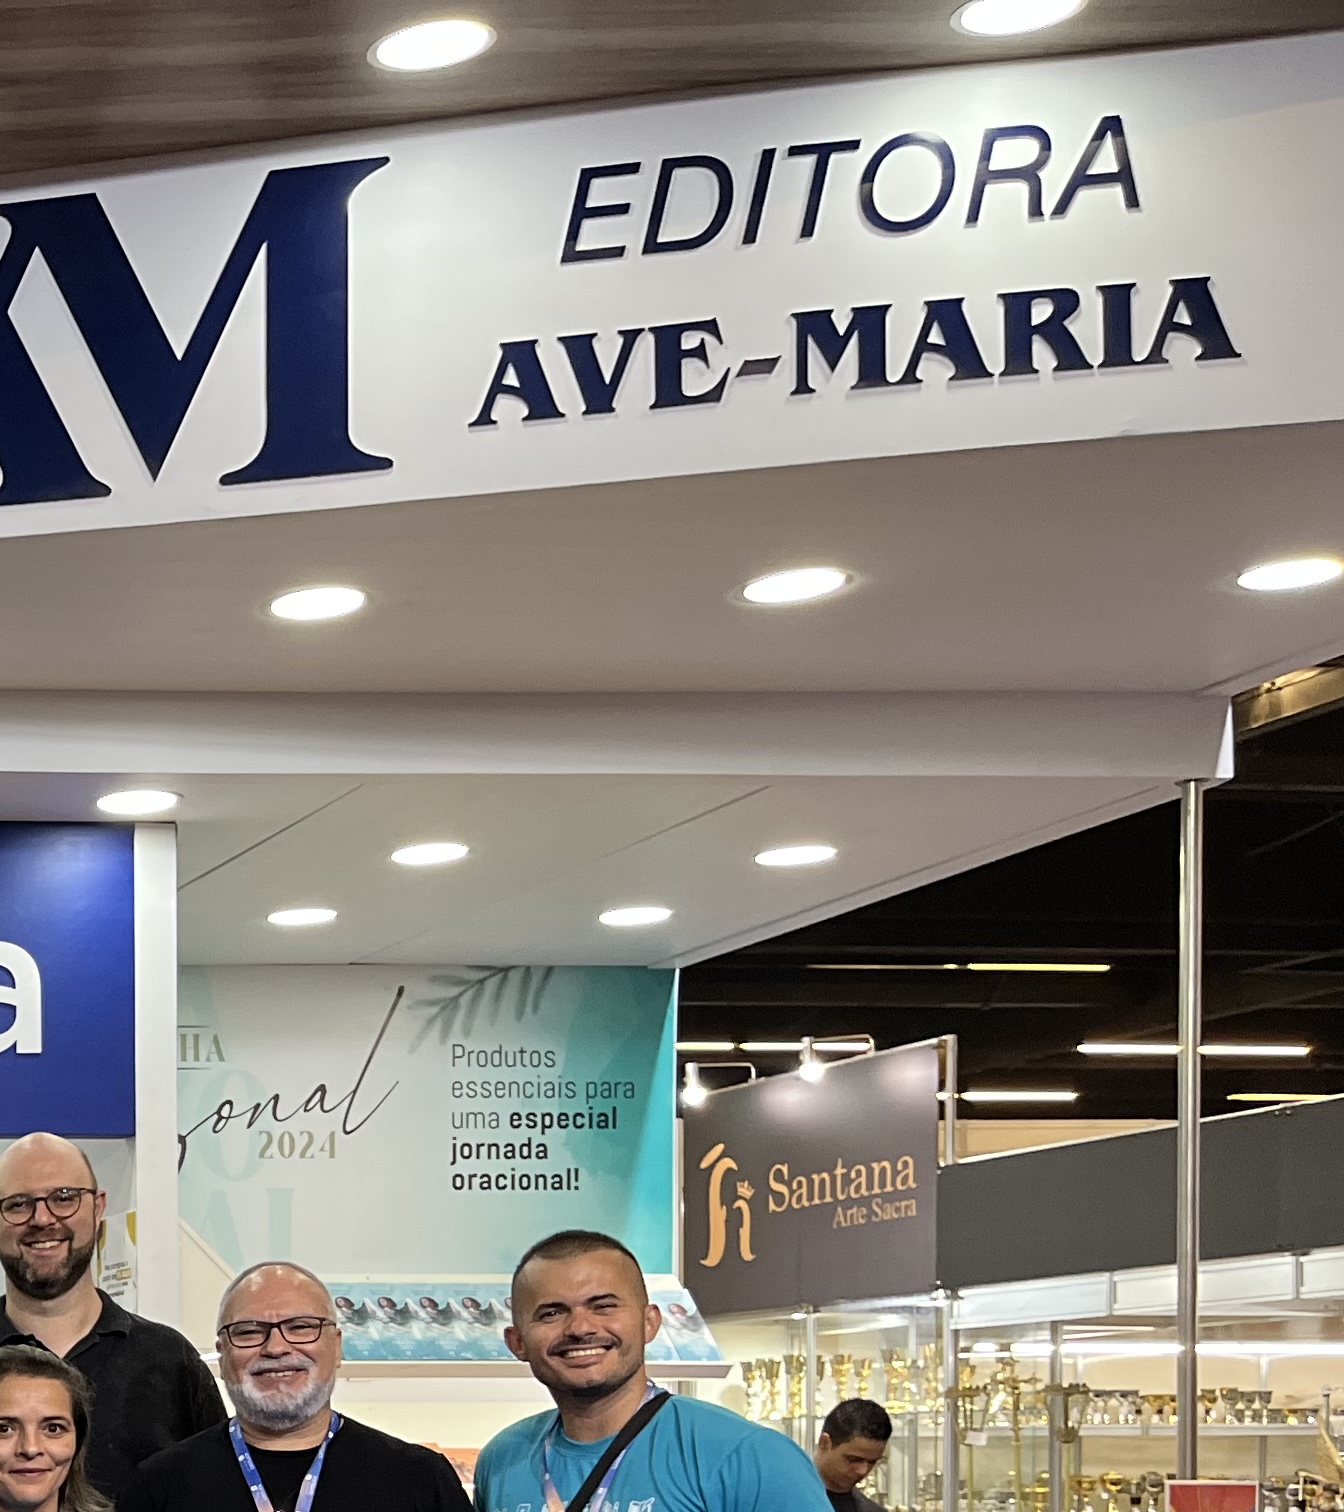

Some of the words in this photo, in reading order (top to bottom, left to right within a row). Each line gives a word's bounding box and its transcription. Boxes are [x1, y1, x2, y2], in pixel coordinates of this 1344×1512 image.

[558, 114, 1144, 265] EDITORA
[467, 274, 1243, 430] AVE-MARIA
[451, 1044, 556, 1068] Produtos
[451, 1075, 577, 1100] essenciais
[585, 1080, 636, 1105] para
[451, 1112, 500, 1130] uma
[509, 1106, 618, 1135] especial
[258, 1131, 336, 1159] 2024
[450, 1137, 549, 1166] jornada
[451, 1168, 580, 1191] oracional!
[768, 1155, 918, 1213] Santana
[832, 1206, 867, 1229] Arte
[871, 1198, 917, 1221] Sacra
